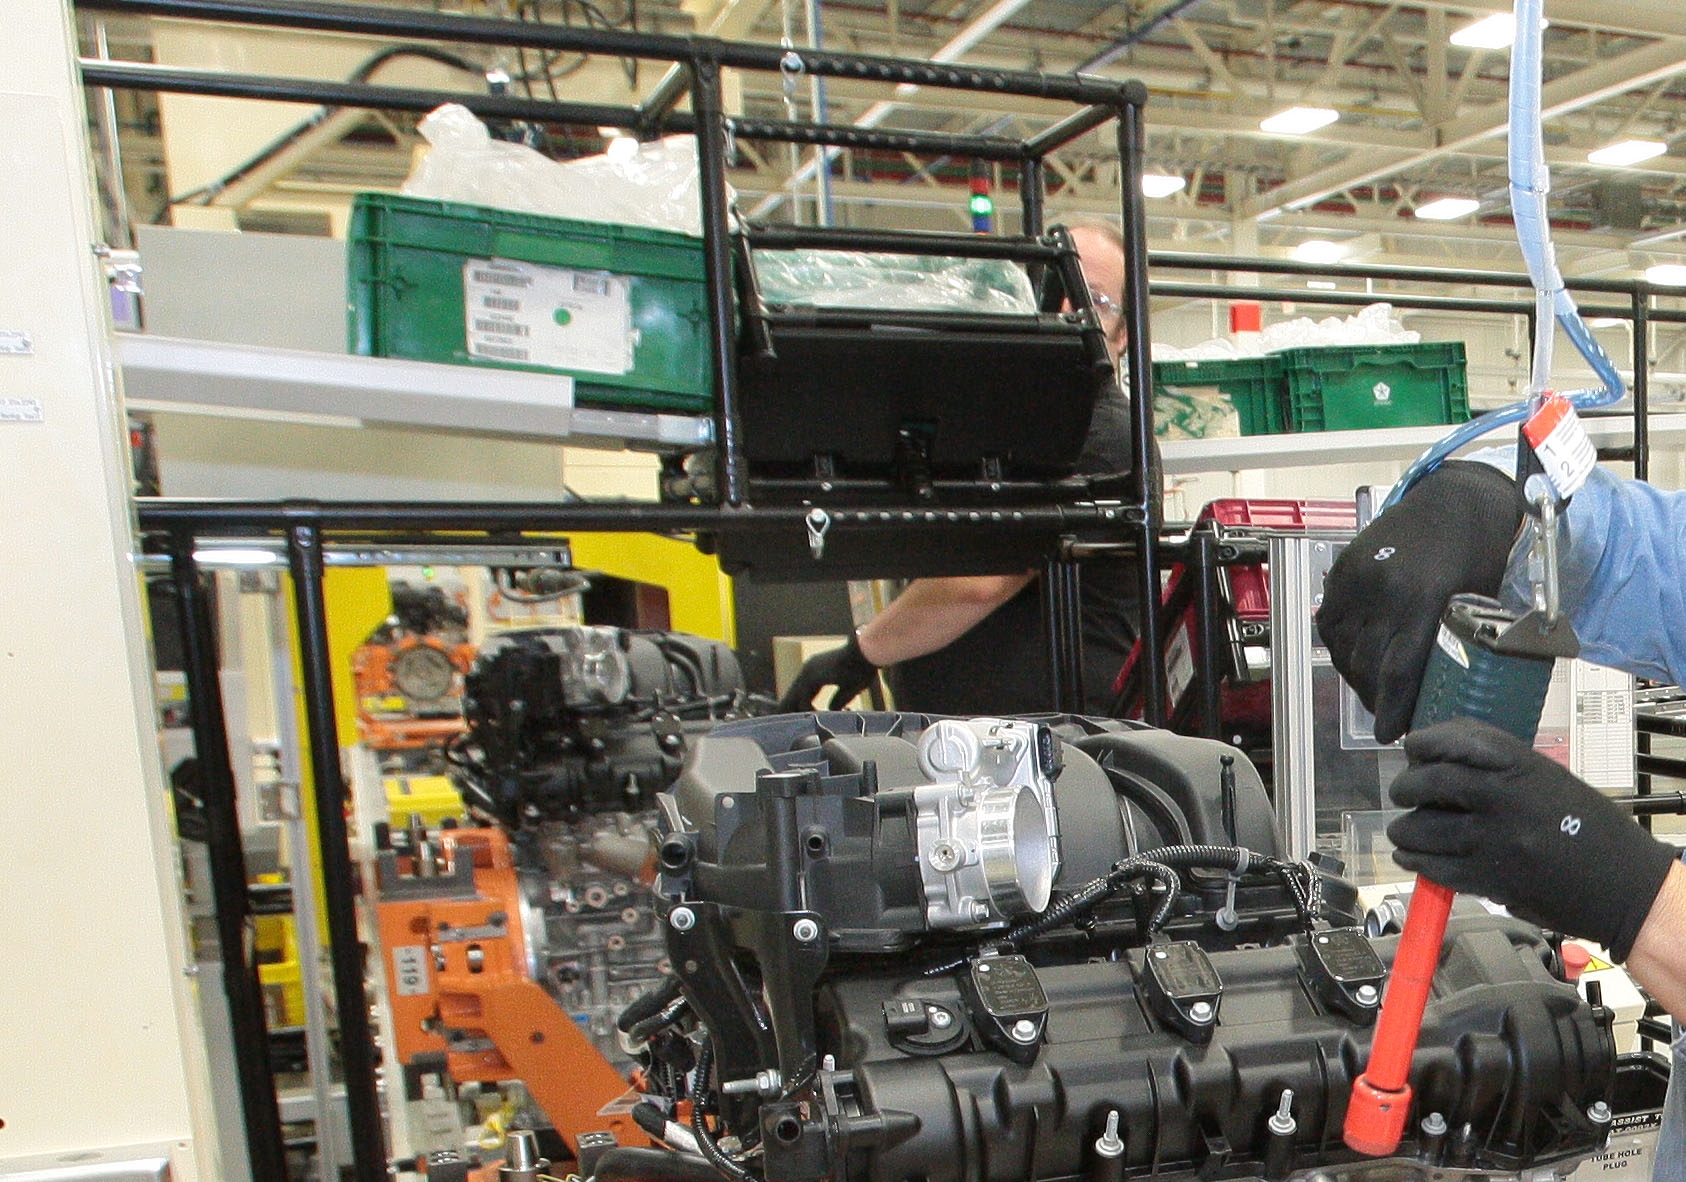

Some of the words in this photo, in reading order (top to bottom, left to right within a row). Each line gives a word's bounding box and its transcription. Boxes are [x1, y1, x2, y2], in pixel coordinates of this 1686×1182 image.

[1543, 444, 1557, 457] 1
[1560, 460, 1576, 478] 2
[1373, 546, 1396, 561] 8
[1560, 814, 1581, 836] 8
[1610, 1115, 1649, 1127] ASSIST
[1590, 1152, 1615, 1163] TUBE
[1617, 1148, 1643, 1159] HOLE
[1602, 1160, 1628, 1171] PLUG
